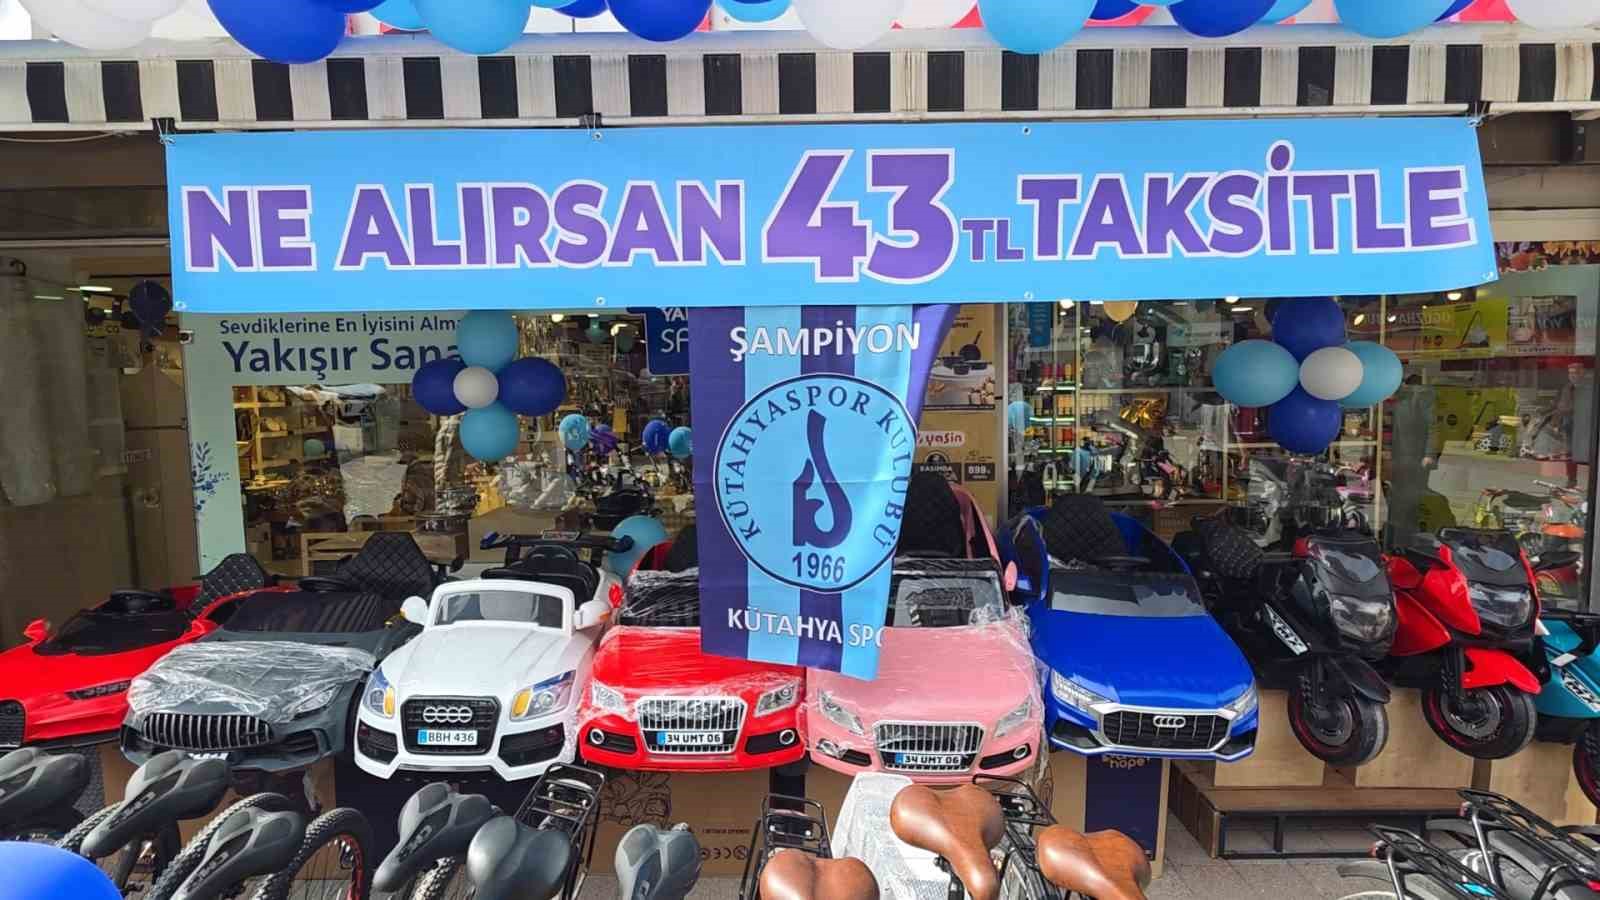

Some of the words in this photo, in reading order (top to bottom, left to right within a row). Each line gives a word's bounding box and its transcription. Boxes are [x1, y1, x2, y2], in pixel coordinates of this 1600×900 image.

[182, 184, 316, 272] NE
[334, 179, 746, 272] ALIRSAN
[762, 148, 959, 284] 43
[961, 216, 1026, 262] TL
[1017, 139, 1478, 260] TAKSİTLE
[219, 318, 330, 335] Sevdiklerine
[335, 317, 357, 332] En
[362, 314, 415, 336] İyisini
[420, 316, 461, 332] Alm
[730, 320, 921, 363] ŞAMPİYON
[222, 338, 358, 381] Yakışır
[725, 384, 871, 541] KÜTAHYASPOR
[872, 407, 911, 549] KULUBÜ
[792, 552, 846, 583] 1966
[727, 606, 842, 645] KÜTAHYA
[428, 732, 451, 743] BBH
[453, 732, 475, 743] 436
[667, 734, 680, 743] 34
[683, 734, 705, 743] UMT
[707, 734, 721, 743] 06
